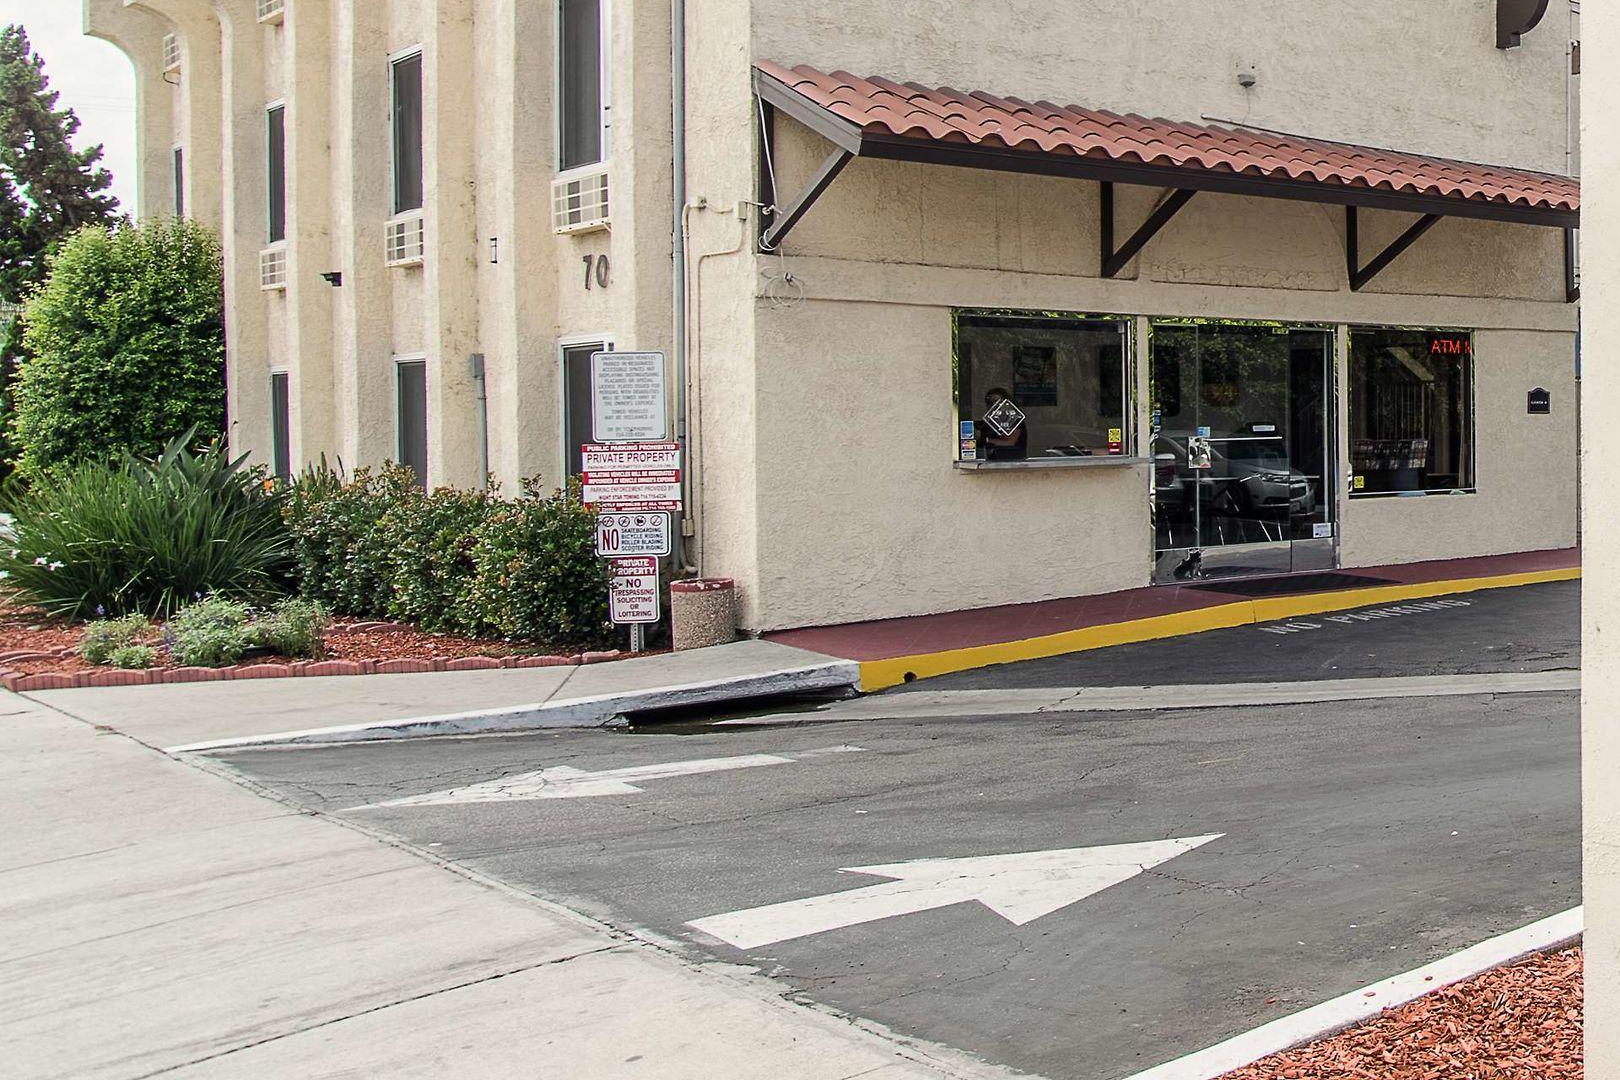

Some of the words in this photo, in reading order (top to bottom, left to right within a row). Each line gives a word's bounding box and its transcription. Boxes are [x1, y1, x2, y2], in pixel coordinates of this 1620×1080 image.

[1431, 339, 1461, 354] ATM
[587, 453, 625, 463] PRIVATE
[627, 452, 676, 462] PROPERTY
[602, 529, 619, 551] NO
[626, 578, 642, 588] NO
[615, 588, 654, 597] TRESPASSING
[1259, 621, 1322, 635] NO
[1324, 598, 1472, 624] PARKING
